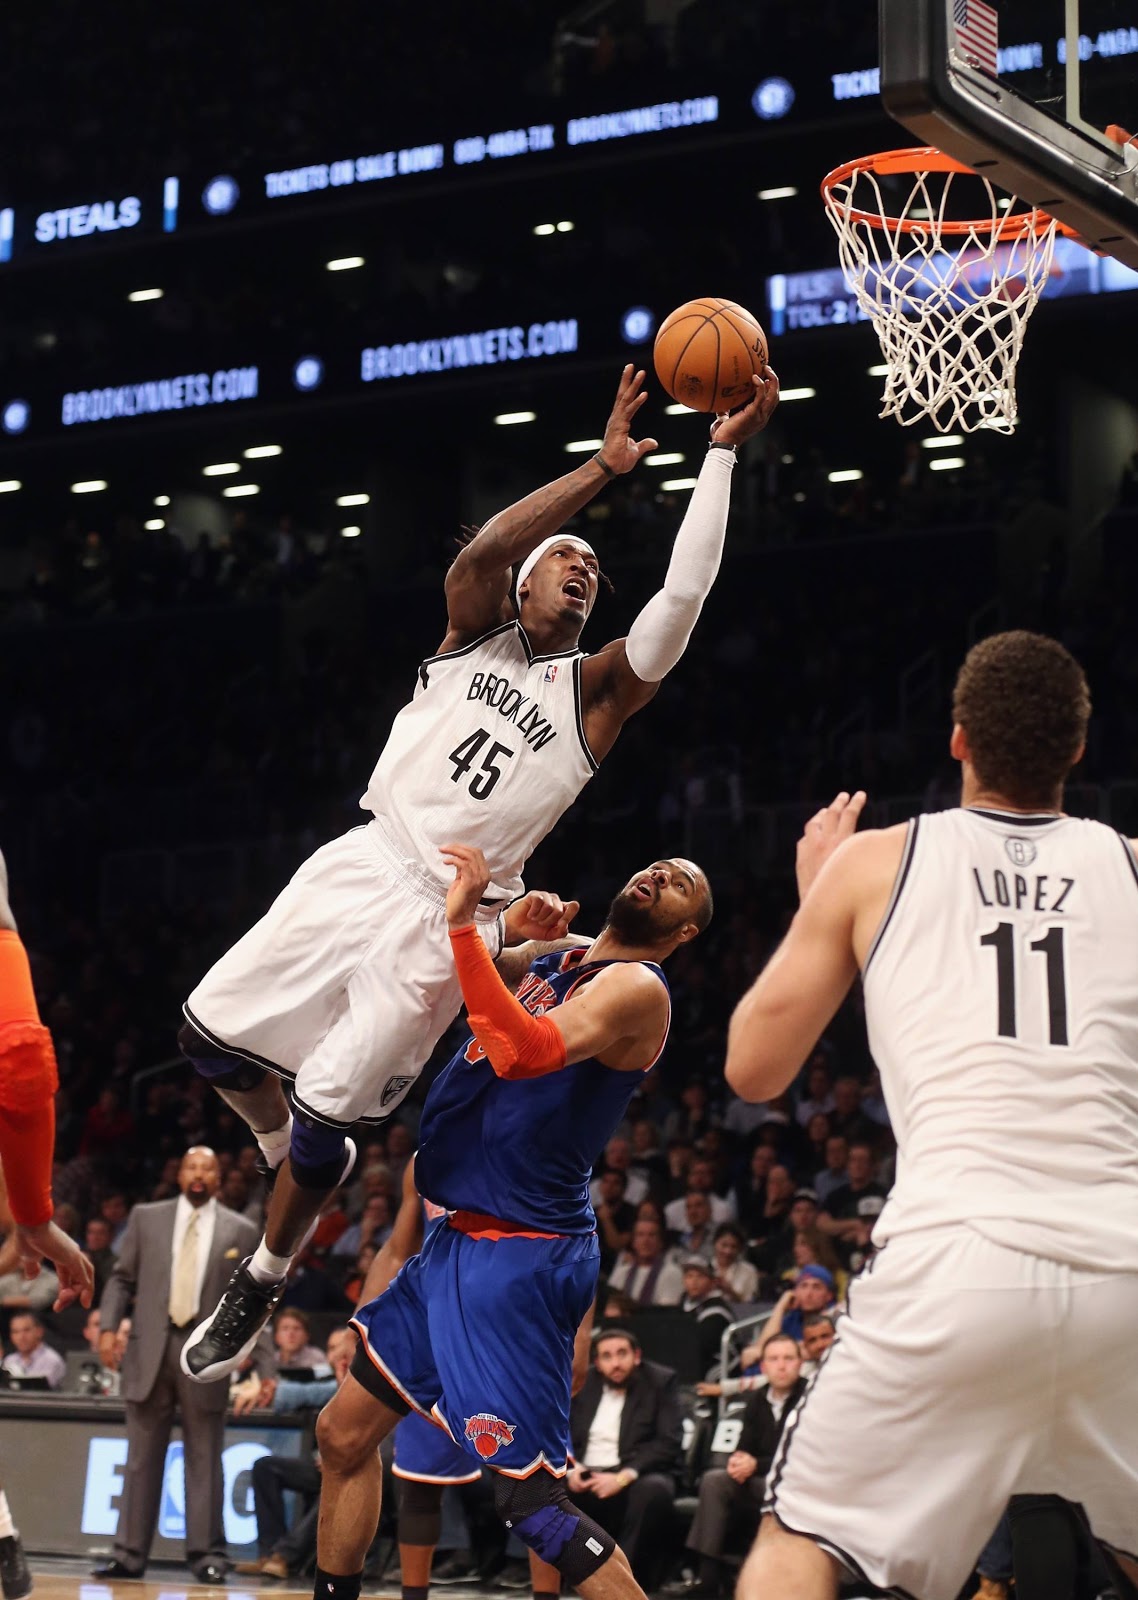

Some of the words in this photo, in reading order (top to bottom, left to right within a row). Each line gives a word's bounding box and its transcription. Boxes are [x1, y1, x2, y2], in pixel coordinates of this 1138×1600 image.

[265, 164, 330, 198] TICKETS
[330, 159, 355, 186] ON
[356, 152, 397, 182] SALE
[566, 95, 719, 146] BROOKLYNNETS.COM
[35, 197, 141, 242] STEALS
[62, 366, 258, 425] BROOKLYNNETS.COM
[361, 318, 578, 382] BROOKLYNNETS.COM
[466, 672, 557, 752] BROOKLYN
[449, 727, 515, 801] 45
[973, 867, 1075, 913] LOPEZ
[980, 921, 1069, 1047] 11
[465, 1416, 514, 1441] KNICKS
